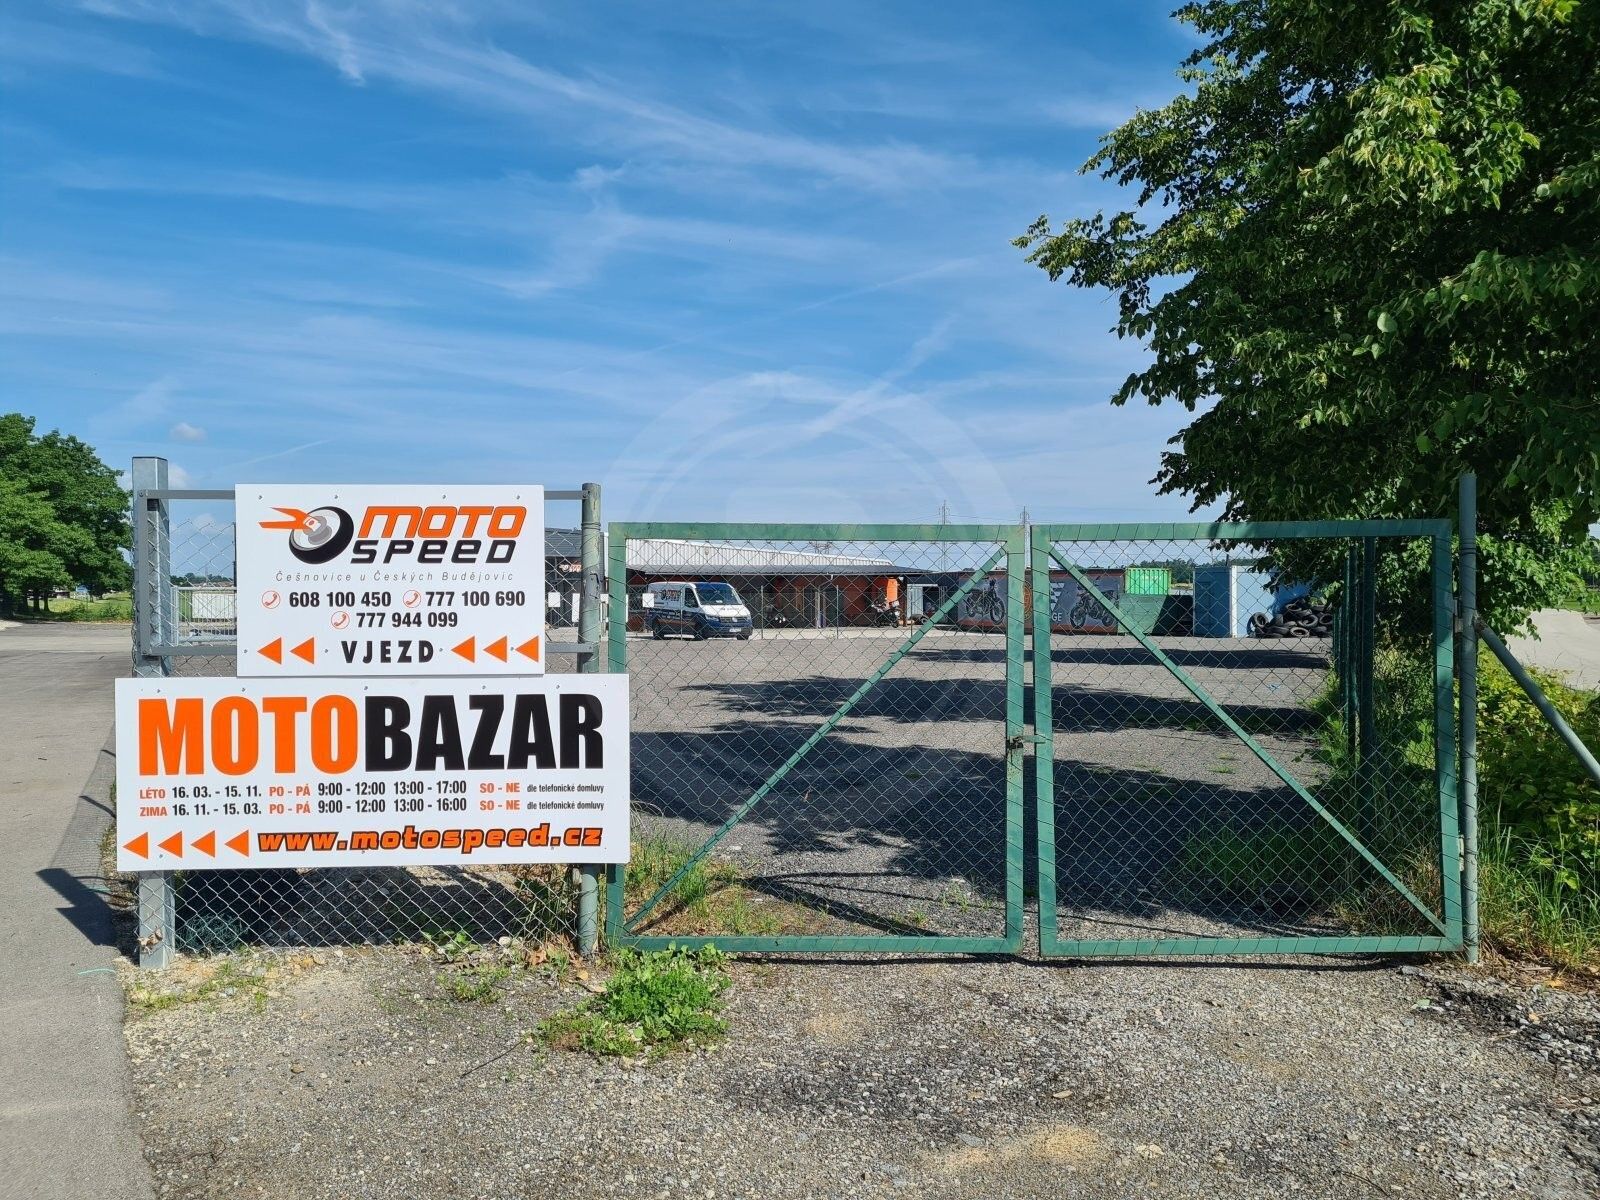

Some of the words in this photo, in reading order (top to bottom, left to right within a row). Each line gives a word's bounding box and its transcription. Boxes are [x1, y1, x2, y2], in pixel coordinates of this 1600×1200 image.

[276, 571, 351, 581] Češnovice
[374, 570, 432, 583] Českých
[442, 572, 512, 582] Budějovic
[289, 592, 320, 607] 608
[327, 592, 355, 607] 100
[361, 592, 391, 607] 450
[426, 592, 455, 606] 777
[462, 591, 489, 606] 100
[496, 591, 525, 606] 690
[356, 613, 385, 627] 777
[392, 612, 422, 627] 944
[428, 612, 457, 627] 099
[341, 640, 433, 664] VJEZD
[139, 694, 603, 775] MOTOBAZAR
[140, 787, 165, 799] LÉTO
[172, 786, 189, 798] 16.
[193, 786, 211, 798] 03.
[225, 786, 241, 797] 15.
[246, 785, 261, 797] 11.
[269, 786, 284, 796] PO
[296, 784, 310, 796] PÁ
[318, 782, 342, 796] 9:00
[355, 782, 385, 795] 12:00
[394, 781, 424, 795] 13:00
[436, 780, 466, 794] 17:00
[480, 783, 494, 793] SO
[506, 783, 520, 793] NE
[539, 784, 575, 792] telefonické
[577, 784, 604, 794] domluvy
[140, 807, 167, 816] ZIMA
[172, 804, 189, 816] 16.
[194, 803, 210, 815] 11.
[223, 803, 239, 815] 15.
[244, 803, 261, 814] 03.
[270, 804, 284, 814] PO
[296, 801, 310, 813] PÁ
[318, 800, 342, 813] 9:00
[355, 799, 385, 812] 12:00
[394, 798, 424, 812] 13:00
[437, 798, 466, 811] 16:00
[480, 800, 494, 810] SO
[506, 800, 520, 810] NE
[539, 801, 575, 809] telefonické
[577, 801, 604, 811] domluvy
[257, 823, 603, 854] www.motospeed.cz
